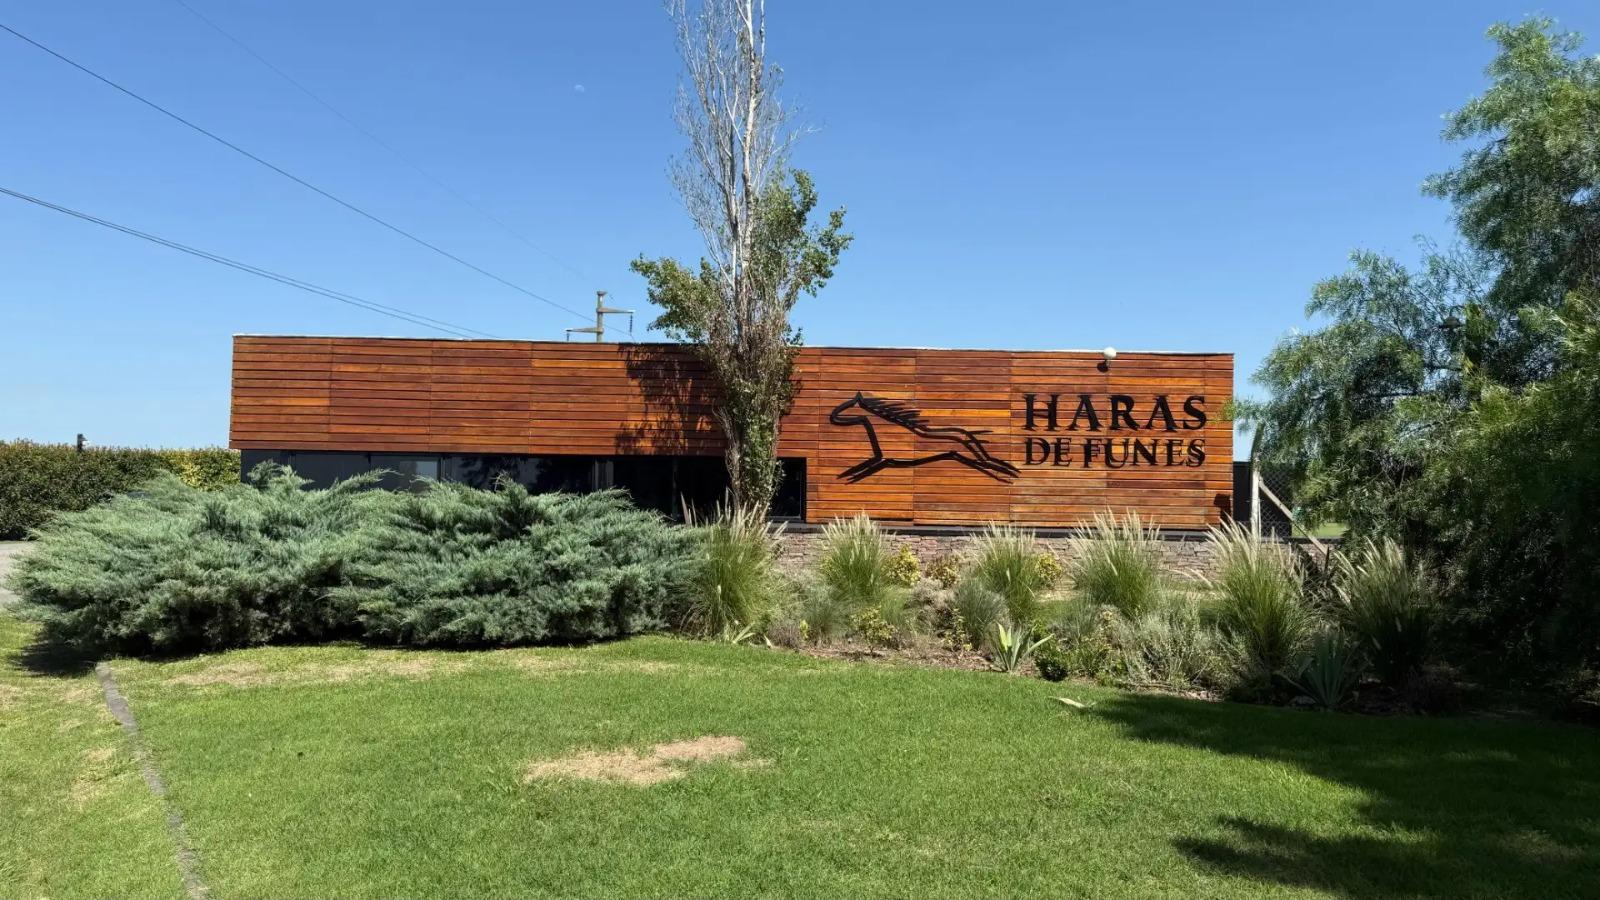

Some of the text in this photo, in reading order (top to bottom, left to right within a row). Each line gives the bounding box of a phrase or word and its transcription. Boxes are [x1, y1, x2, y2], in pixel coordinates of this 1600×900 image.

[1024, 393, 1207, 432] HARAS
[1025, 437, 1206, 468] DE FUNES
